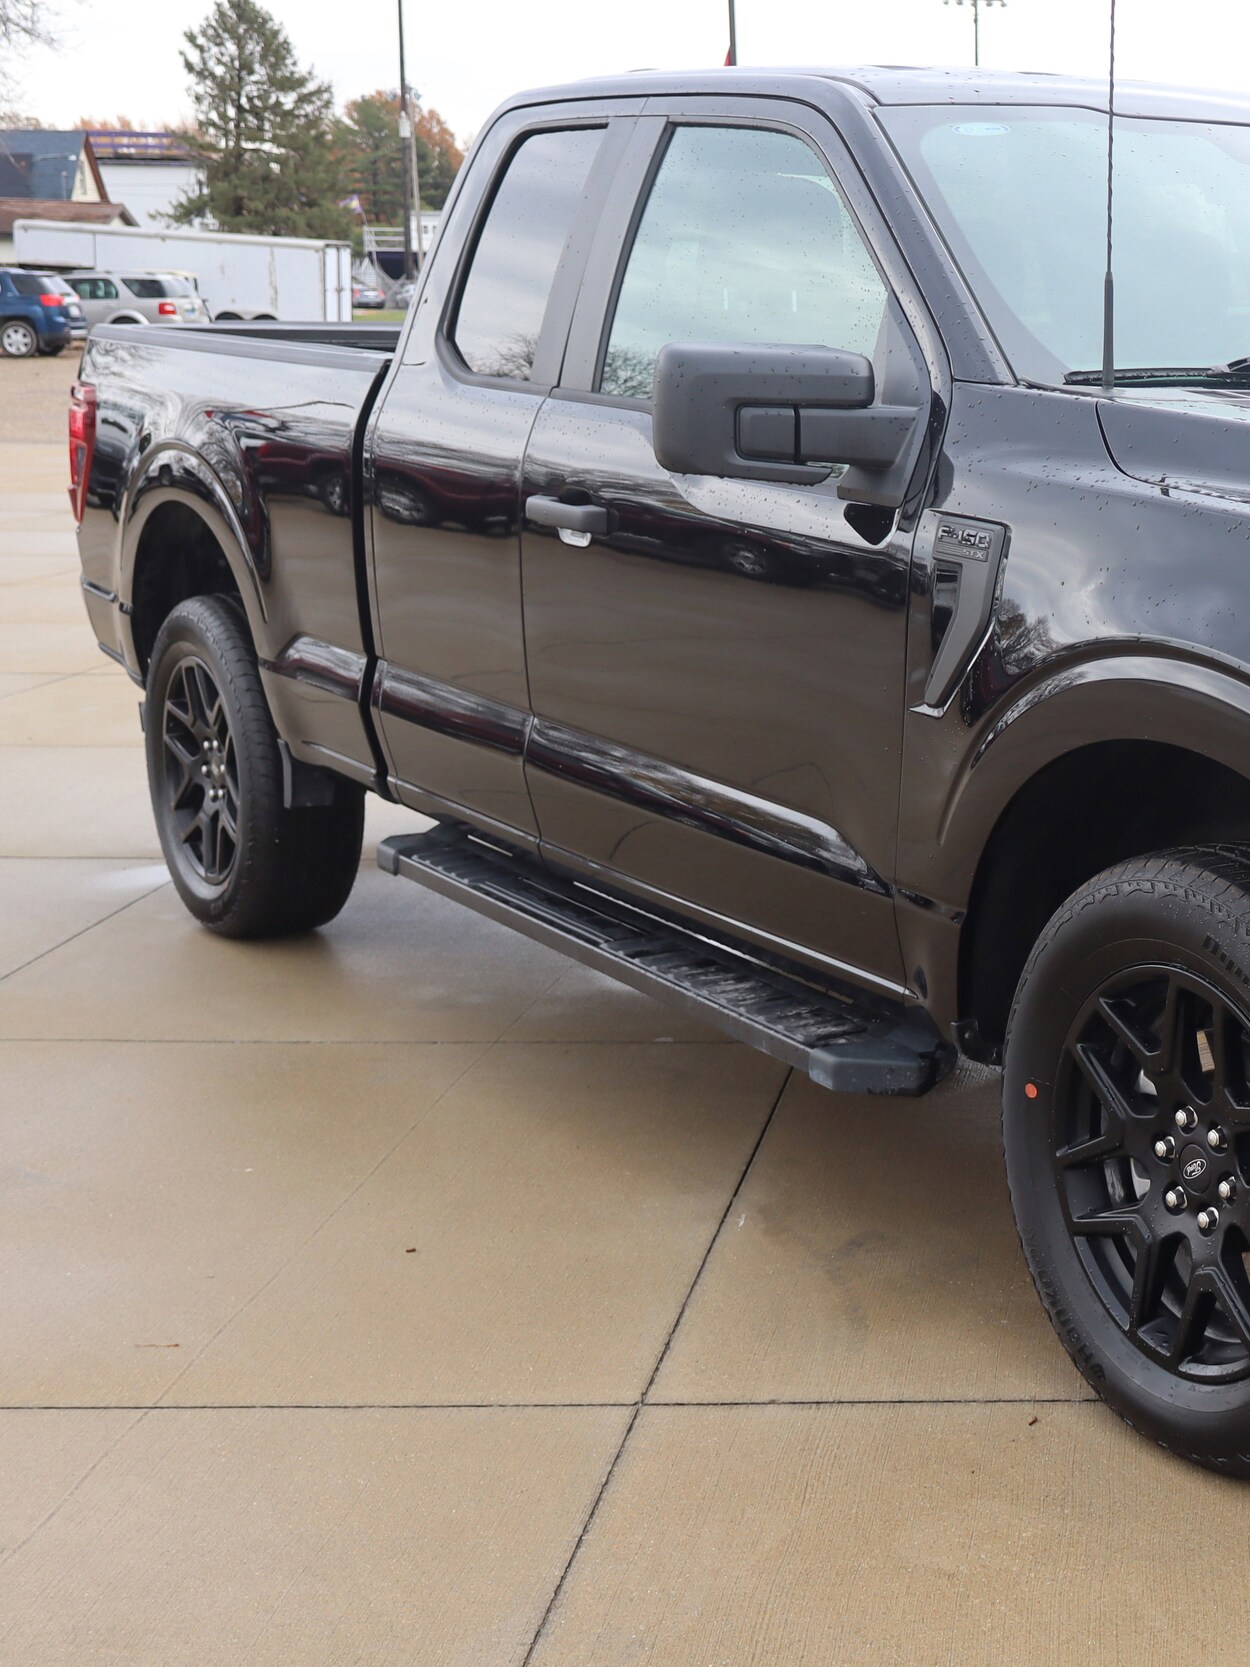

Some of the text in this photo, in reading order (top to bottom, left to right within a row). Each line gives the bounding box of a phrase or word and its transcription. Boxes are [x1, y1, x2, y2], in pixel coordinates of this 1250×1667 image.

[938, 525, 991, 549] F-150
[962, 548, 984, 559] STX
[1187, 1160, 1201, 1176] Ford
